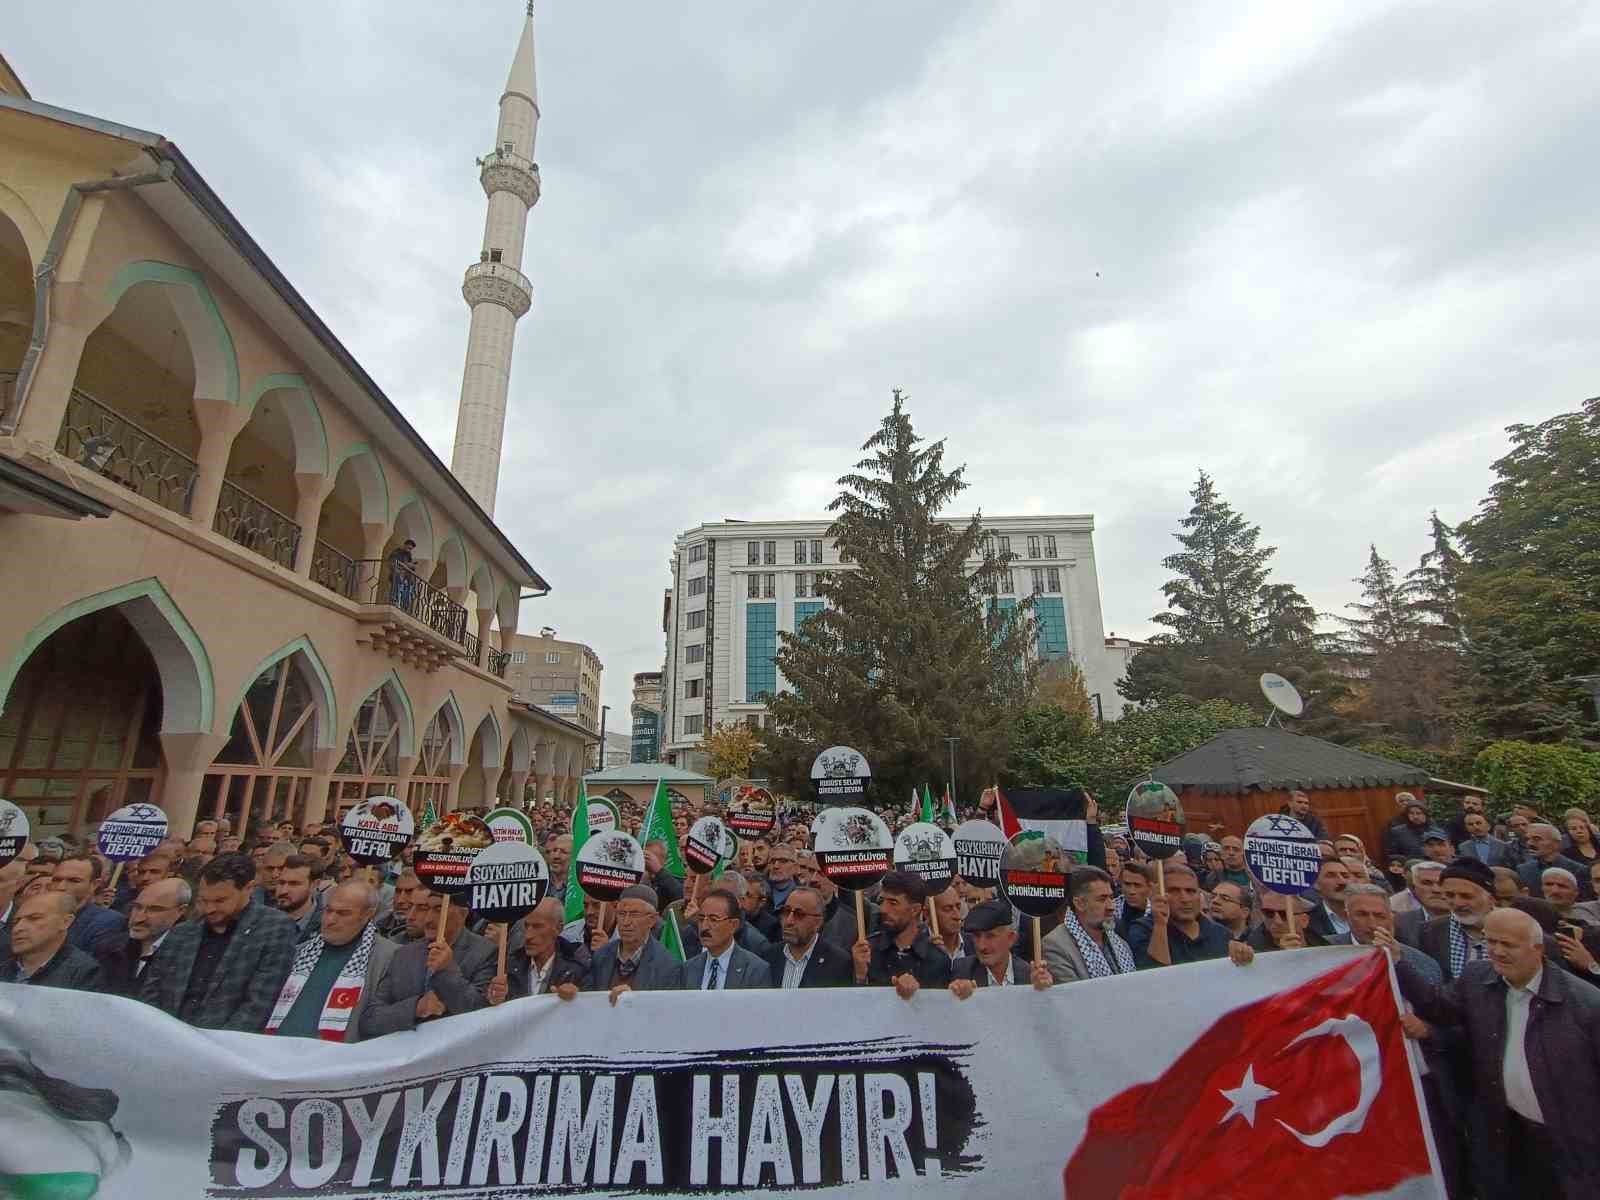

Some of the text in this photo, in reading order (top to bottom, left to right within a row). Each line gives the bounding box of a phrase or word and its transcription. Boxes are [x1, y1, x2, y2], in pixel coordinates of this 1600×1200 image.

[105, 843, 145, 857] DEFOL
[350, 838, 392, 858] DEFOL
[825, 851, 888, 863] İNSANLIK ÖLÜYOR
[1248, 839, 1290, 855] SİYONİST
[472, 863, 537, 880] SOYKIRIMA
[1251, 853, 1319, 873] FİLİSTİN'DEN
[1262, 866, 1310, 887] DEFOL
[472, 882, 537, 909] HAYIR!
[234, 1071, 942, 1189] SOYKIRIMA HAYIR!
